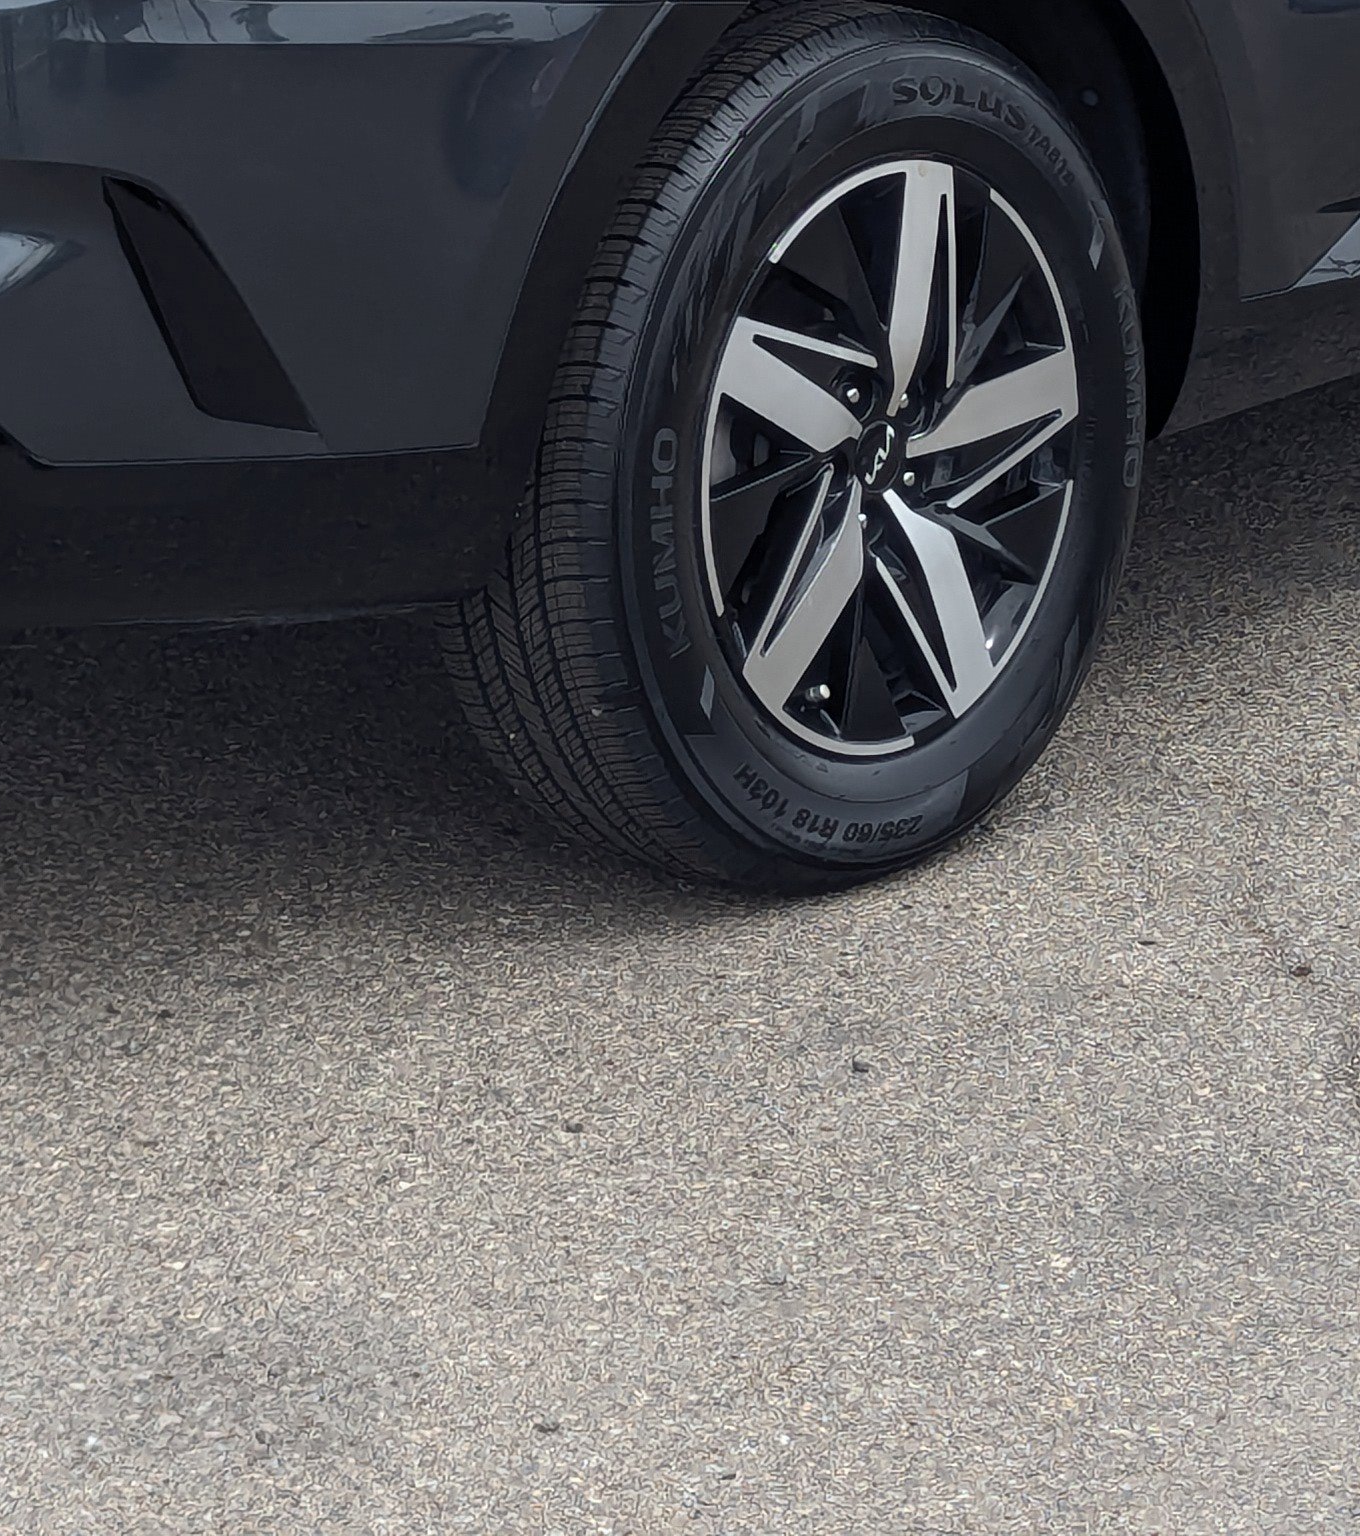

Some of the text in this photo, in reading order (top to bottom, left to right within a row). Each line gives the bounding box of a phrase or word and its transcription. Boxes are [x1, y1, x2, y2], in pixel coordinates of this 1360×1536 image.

[891, 75, 1028, 132] SOLUS
[1113, 283, 1143, 489] KUMHO
[649, 427, 692, 661] KUMHO
[791, 808, 840, 844] R18
[841, 814, 924, 844] 235/60
